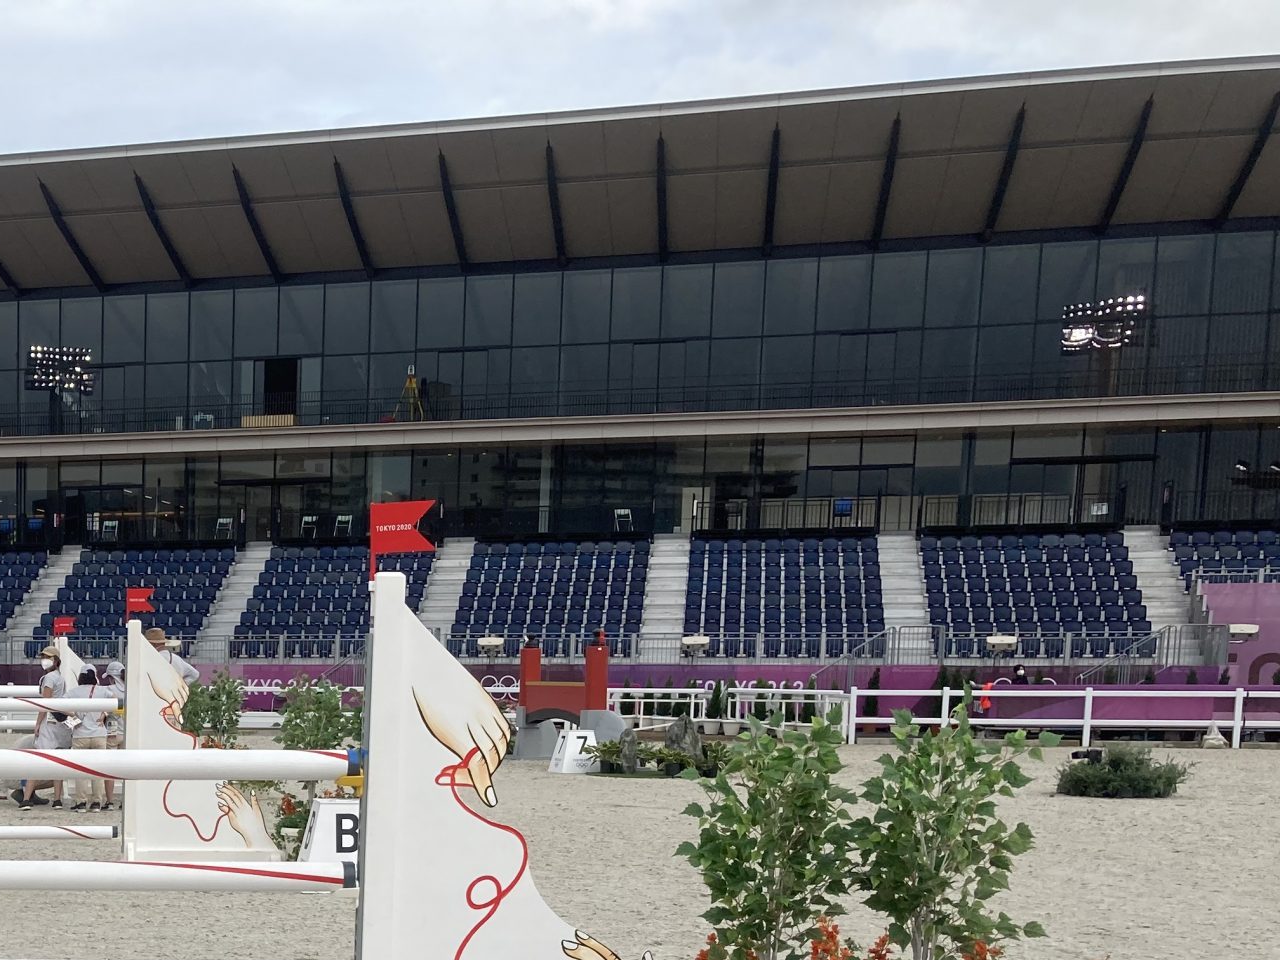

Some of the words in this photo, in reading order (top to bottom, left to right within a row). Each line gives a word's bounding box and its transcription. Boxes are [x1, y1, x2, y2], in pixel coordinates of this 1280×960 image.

[376, 524, 396, 532] TOKYO
[397, 523, 412, 531] 2020
[576, 736, 588, 755] 7
[335, 813, 360, 854] B
